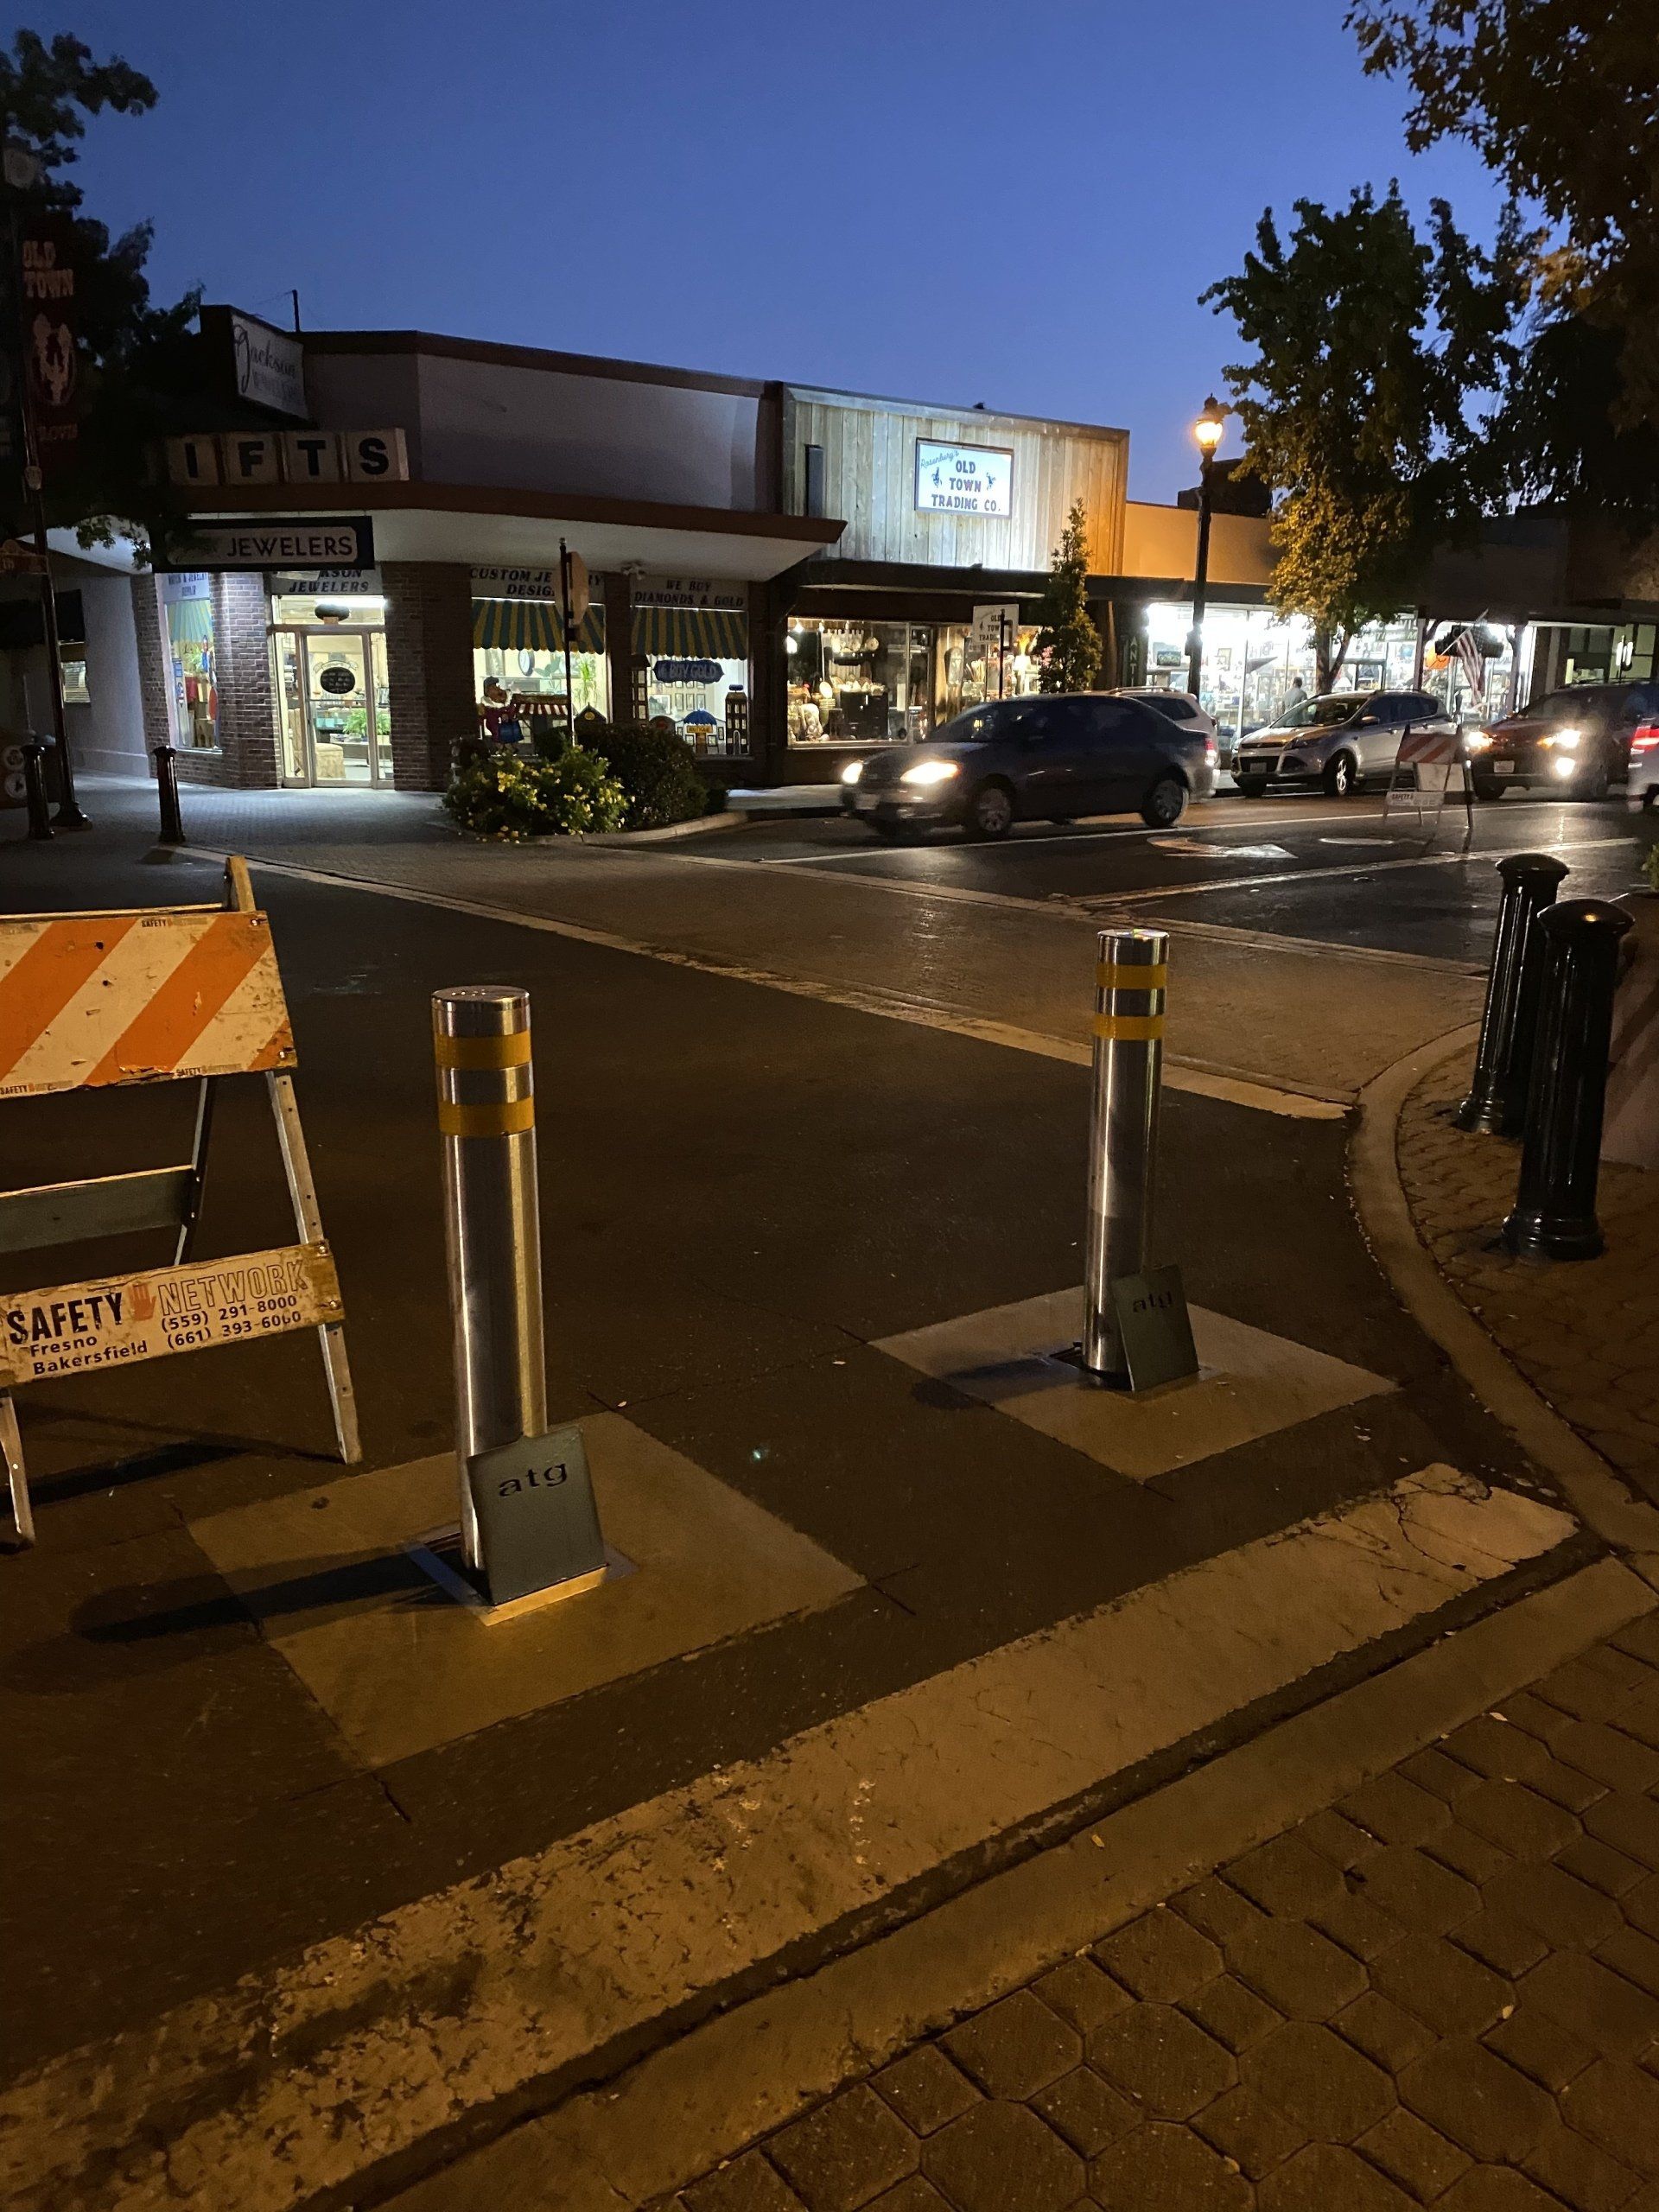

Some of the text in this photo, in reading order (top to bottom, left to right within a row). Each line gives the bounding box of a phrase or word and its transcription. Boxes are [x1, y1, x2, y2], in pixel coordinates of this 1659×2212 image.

[23, 269, 74, 299] TOWN
[184, 437, 390, 478] IFTS
[955, 460, 976, 474] OLD
[949, 477, 982, 493] TOWN
[931, 493, 1001, 512] TRADING CO.
[227, 537, 353, 556] JEWELERS
[470, 568, 530, 582] CUSTOM
[289, 581, 369, 593] JEWELERS
[506, 583, 556, 597] DESIG
[634, 591, 694, 605] DIAMONDS
[715, 595, 744, 607] GOLD
[141, 919, 167, 928] SAFETY
[175, 1067, 202, 1077] SAFETY
[0, 1084, 29, 1096] SAFETY
[7, 1261, 308, 1344] SAFETY NETWORK
[30, 1294, 298, 1357] Fresno (559) 291-8000
[34, 1341, 148, 1376] Bakersfield
[168, 1327, 212, 1351] (661)
[498, 1463, 568, 1497] atg
